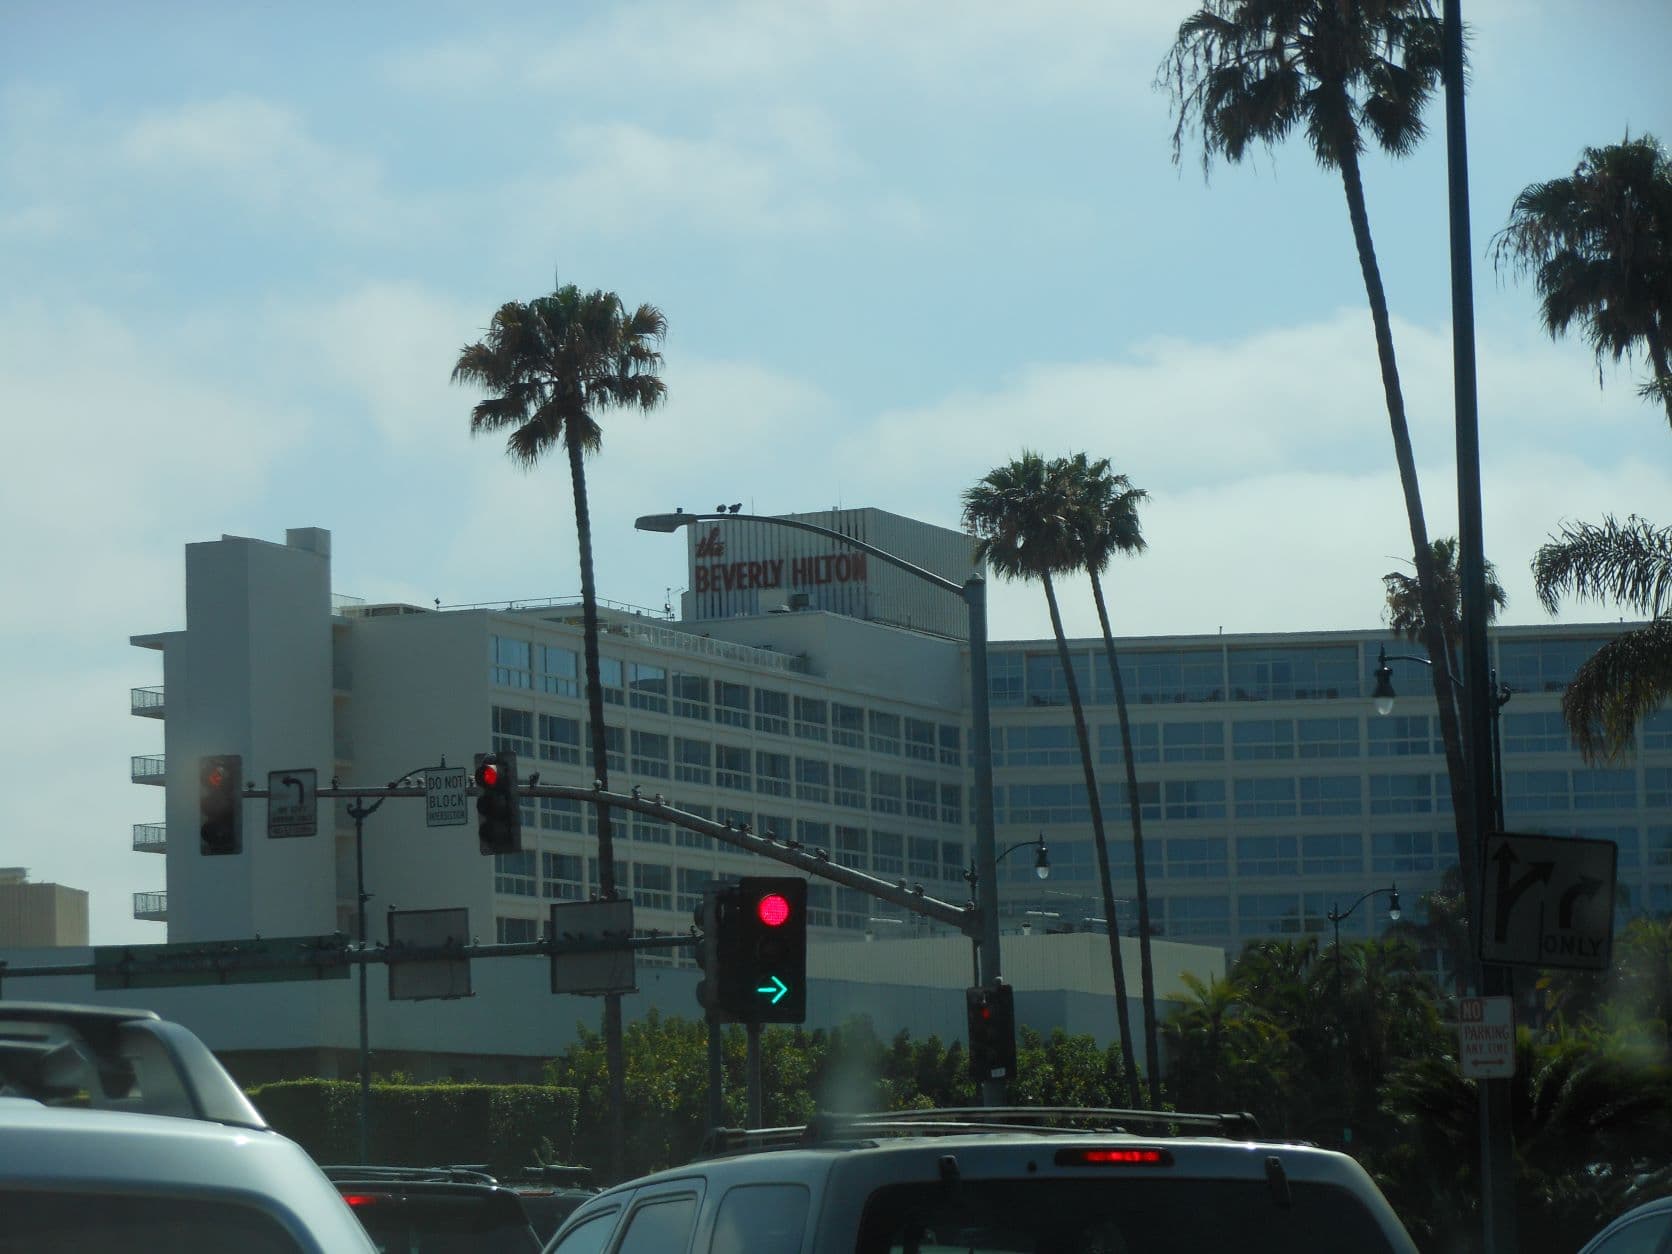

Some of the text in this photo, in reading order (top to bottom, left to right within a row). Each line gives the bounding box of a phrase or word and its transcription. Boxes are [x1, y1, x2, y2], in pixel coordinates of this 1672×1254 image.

[695, 527, 725, 558] the
[695, 553, 867, 593] BEVERLY HILTON
[428, 775, 463, 790] DO NOT
[429, 793, 464, 808] BLOCK
[1544, 935, 1603, 957] ONLY
[1462, 1000, 1481, 1020] NO
[1464, 1024, 1510, 1040] PARKING
[1466, 1043, 1508, 1056] ANY TIME
